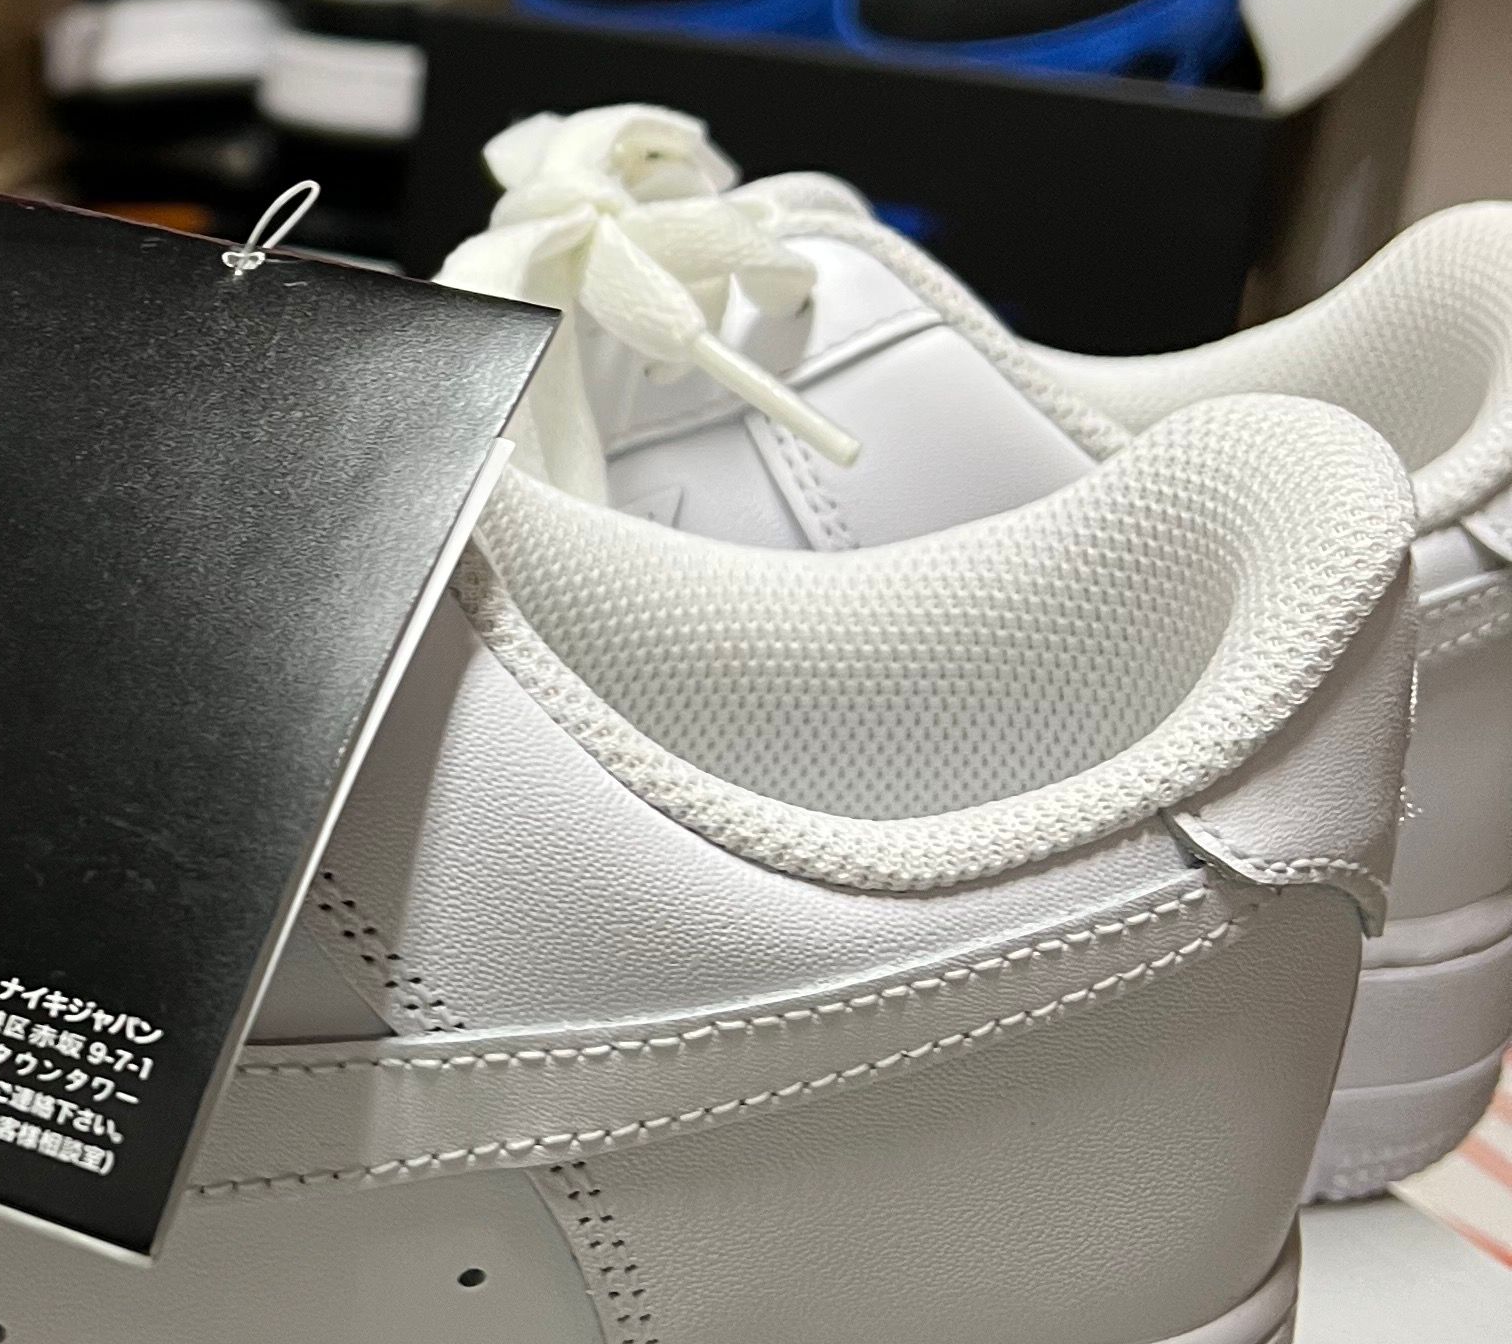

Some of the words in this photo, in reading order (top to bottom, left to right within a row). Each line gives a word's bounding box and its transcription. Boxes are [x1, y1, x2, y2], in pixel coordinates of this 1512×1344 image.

[0, 978, 164, 1043] ナイキジャパン
